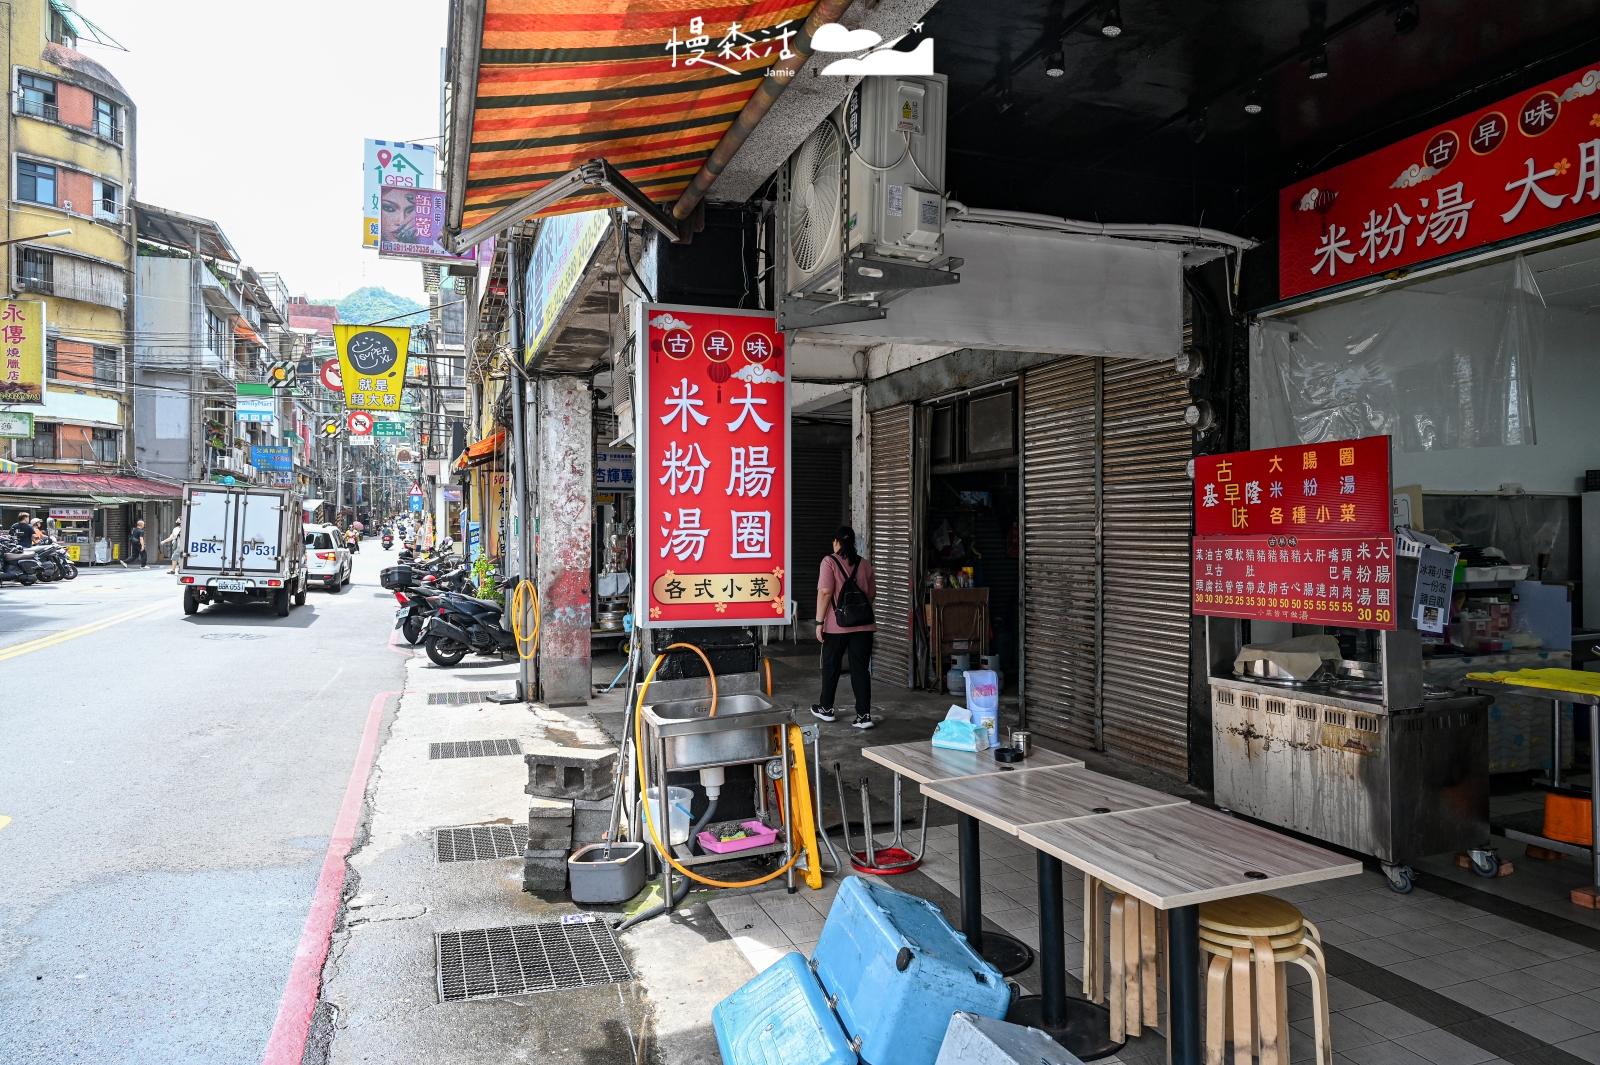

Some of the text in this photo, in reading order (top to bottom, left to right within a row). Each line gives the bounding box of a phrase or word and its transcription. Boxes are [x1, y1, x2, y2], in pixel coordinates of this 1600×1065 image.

[1429, 99, 1555, 165] 古早味
[385, 174, 413, 187] GPS
[433, 196, 442, 225] 美甲
[1310, 181, 1476, 276] 米粉湯
[667, 333, 769, 359] 古早味
[358, 378, 388, 392] 就是
[350, 393, 397, 407] 超大杯
[376, 422, 402, 430] 仁二路
[1269, 446, 1355, 473] 大腸圈
[658, 377, 711, 562] 米粉湯
[725, 383, 776, 559] 大腸圈
[1269, 475, 1356, 499] 米粉湯
[1269, 503, 1356, 526] 各種小菜
[1268, 537, 1298, 547] 古早味
[191, 542, 222, 553] BBK-
[665, 577, 770, 600] 各式小菜
[1196, 594, 1203, 603] 30
[1205, 594, 1213, 603] 30
[1215, 595, 1223, 604] 30
[1225, 595, 1233, 604] 25
[1235, 596, 1244, 605] 25
[1246, 596, 1254, 606] 35
[1257, 597, 1266, 607] 30
[1268, 598, 1277, 607] 30
[1279, 598, 1289, 608] 50
[1291, 599, 1301, 609] 50
[1303, 600, 1314, 610] 55
[1316, 601, 1327, 610] 55
[1329, 601, 1340, 611] 55
[1342, 602, 1353, 612] 55
[1357, 608, 1372, 621] 30
[1375, 609, 1390, 622] 50
